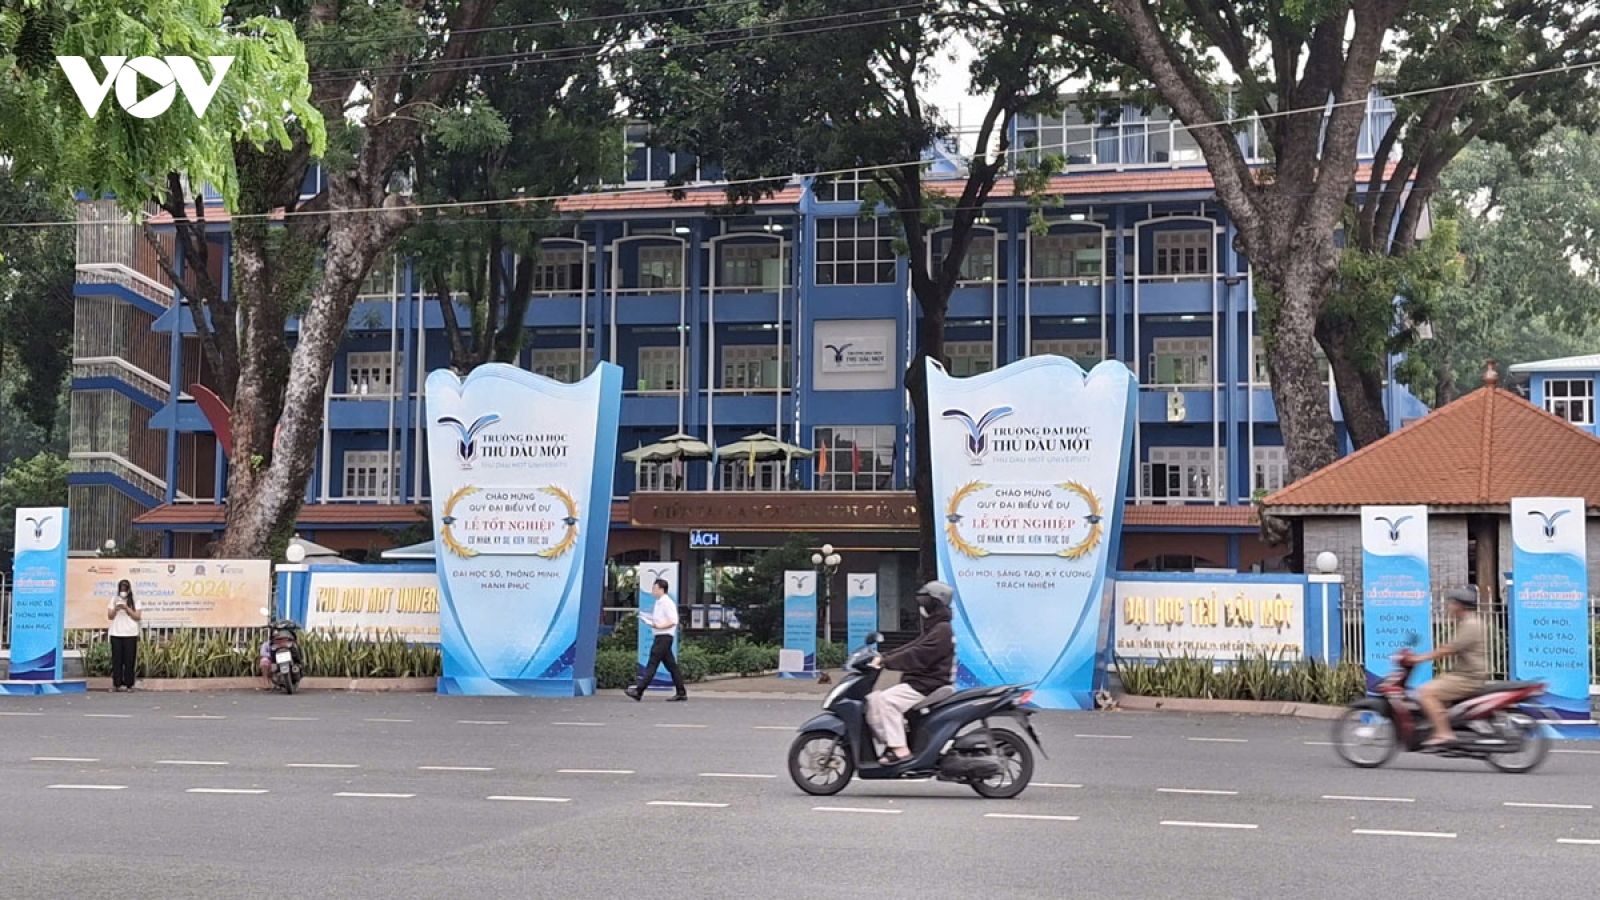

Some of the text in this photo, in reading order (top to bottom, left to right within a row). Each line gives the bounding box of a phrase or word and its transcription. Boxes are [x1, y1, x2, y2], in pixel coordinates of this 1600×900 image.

[1167, 391, 1186, 422] B
[181, 580, 227, 597] 2024
[316, 587, 440, 614] THU DAU MOT UNIVER
